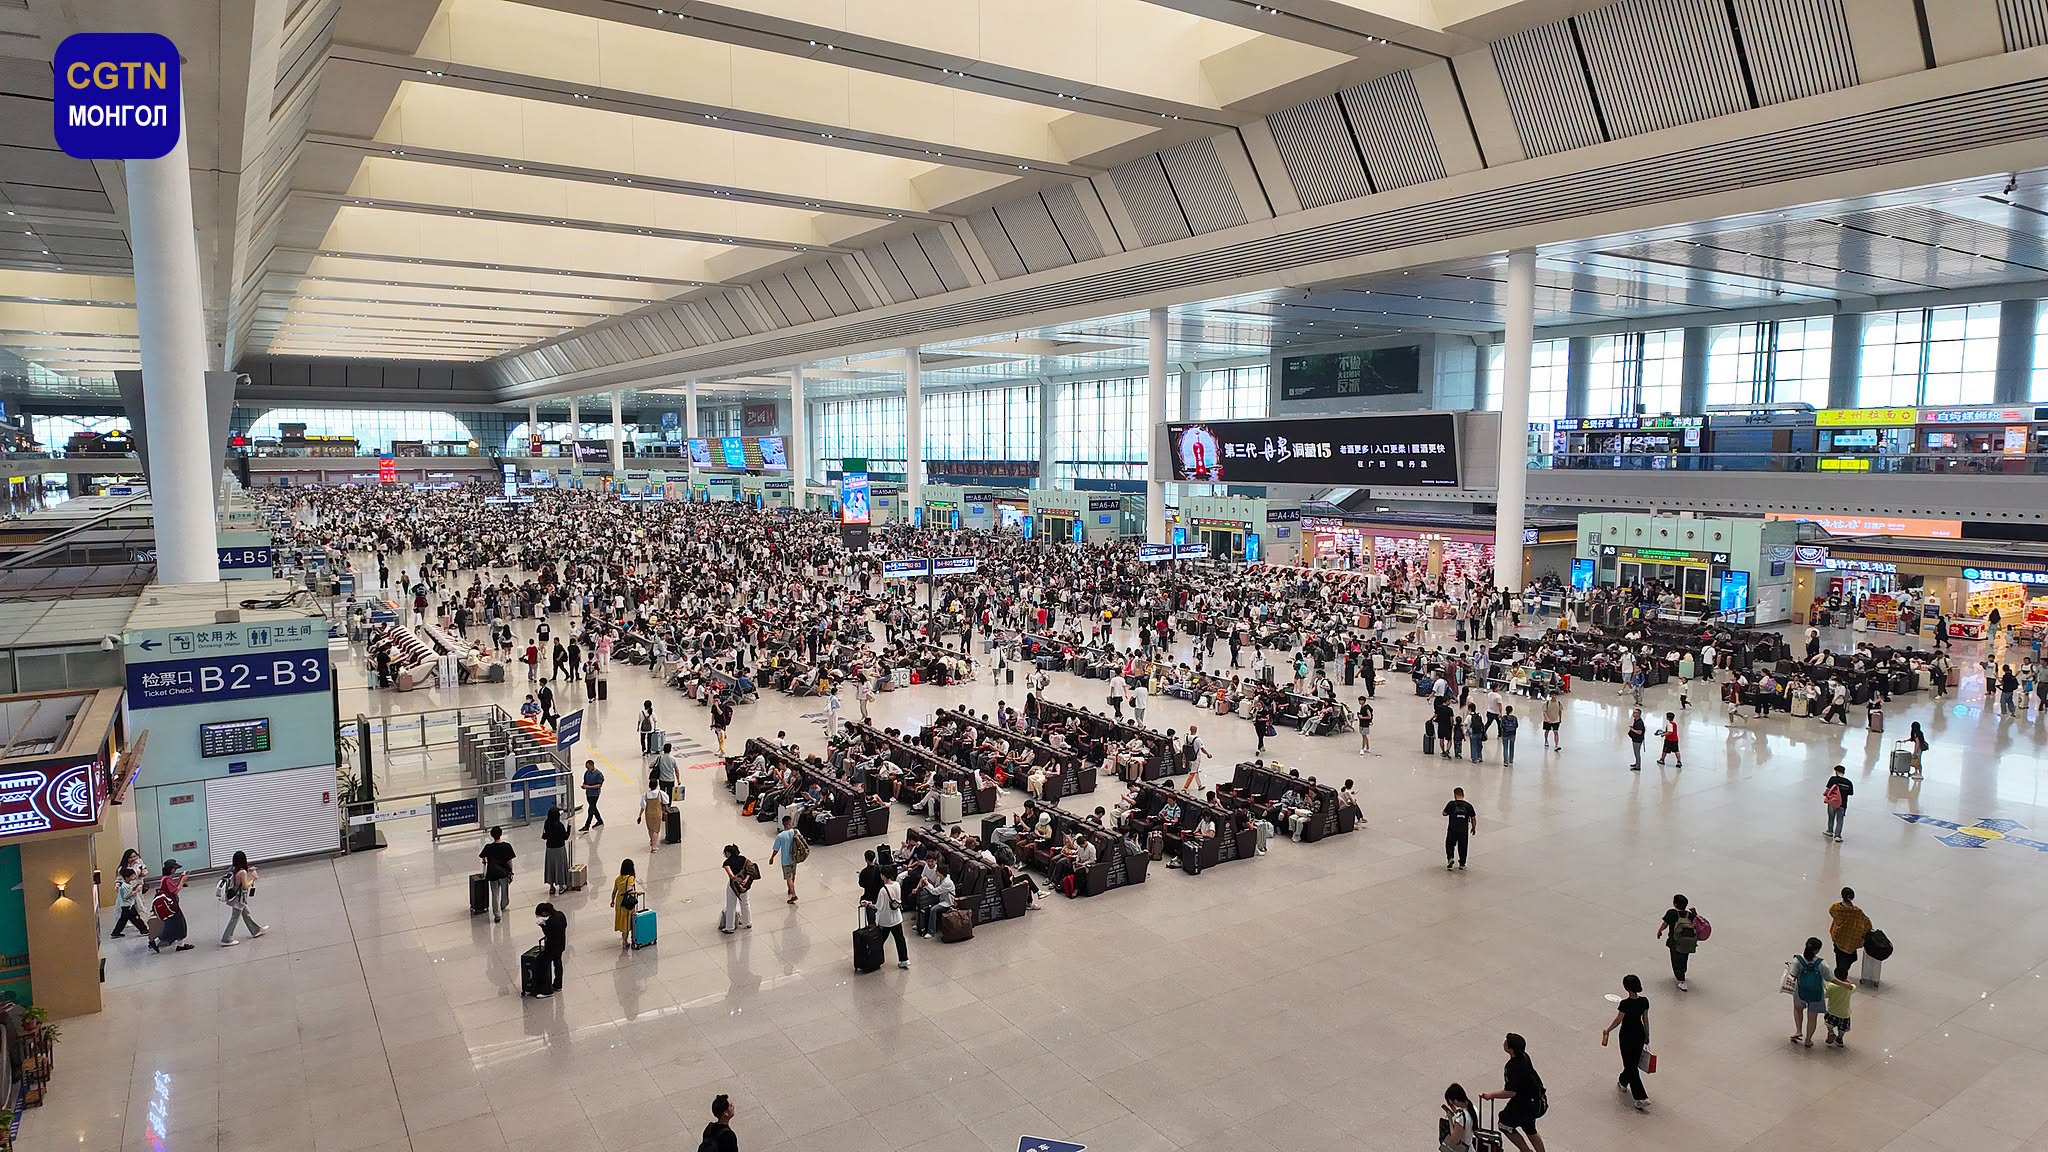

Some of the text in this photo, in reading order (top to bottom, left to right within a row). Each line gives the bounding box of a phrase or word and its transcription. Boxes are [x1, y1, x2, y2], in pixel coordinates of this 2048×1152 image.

[1098, 501, 1119, 509] A6-A7
[1277, 511, 1300, 519] A4-A5
[1603, 546, 1616, 555] A3
[217, 550, 268, 564] 4-B5
[1713, 554, 1728, 563] A2
[1979, 569, 2048, 584] 进口食品店
[196, 625, 312, 643] 饮用水 卫生间
[141, 671, 193, 688] 检票口
[200, 658, 321, 692] B2-B3
[143, 687, 195, 698] Ticket Check
